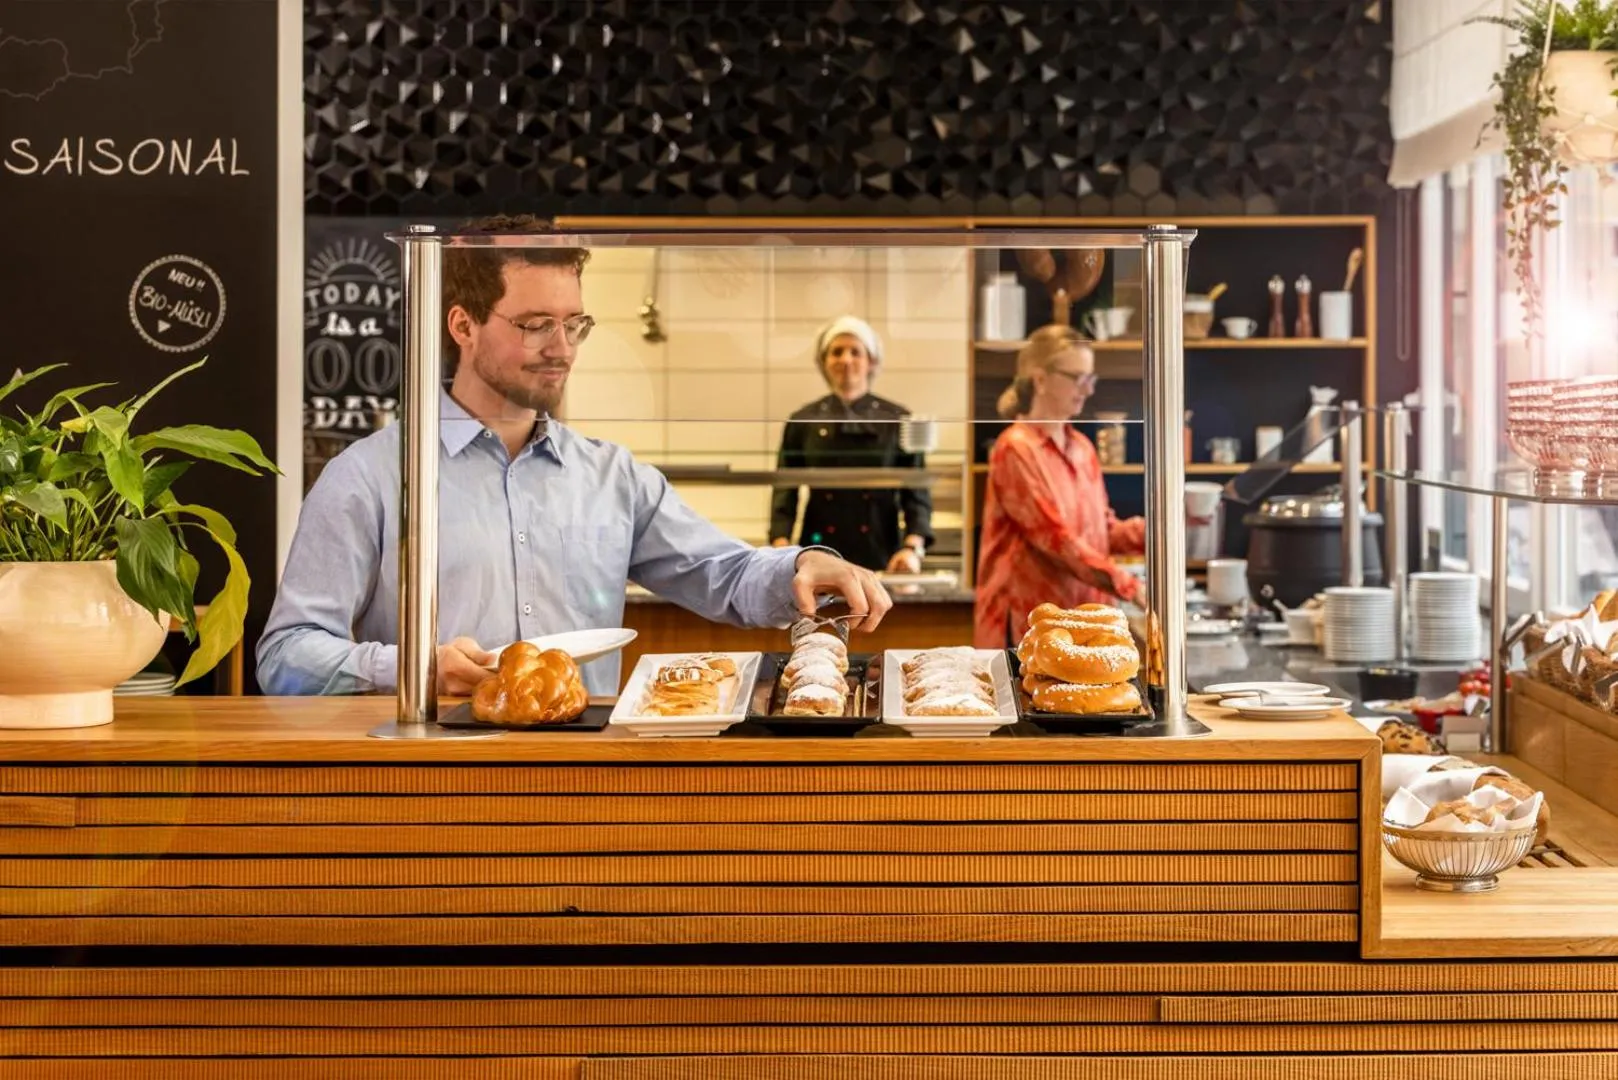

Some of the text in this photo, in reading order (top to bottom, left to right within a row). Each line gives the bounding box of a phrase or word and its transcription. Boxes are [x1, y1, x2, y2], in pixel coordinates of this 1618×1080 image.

[4, 137, 250, 176] SAISONAL
[139, 285, 212, 328] BIO-MÜSLI
[306, 282, 400, 310] TODAY
[321, 312, 383, 336] is a
[305, 337, 400, 394] OO
